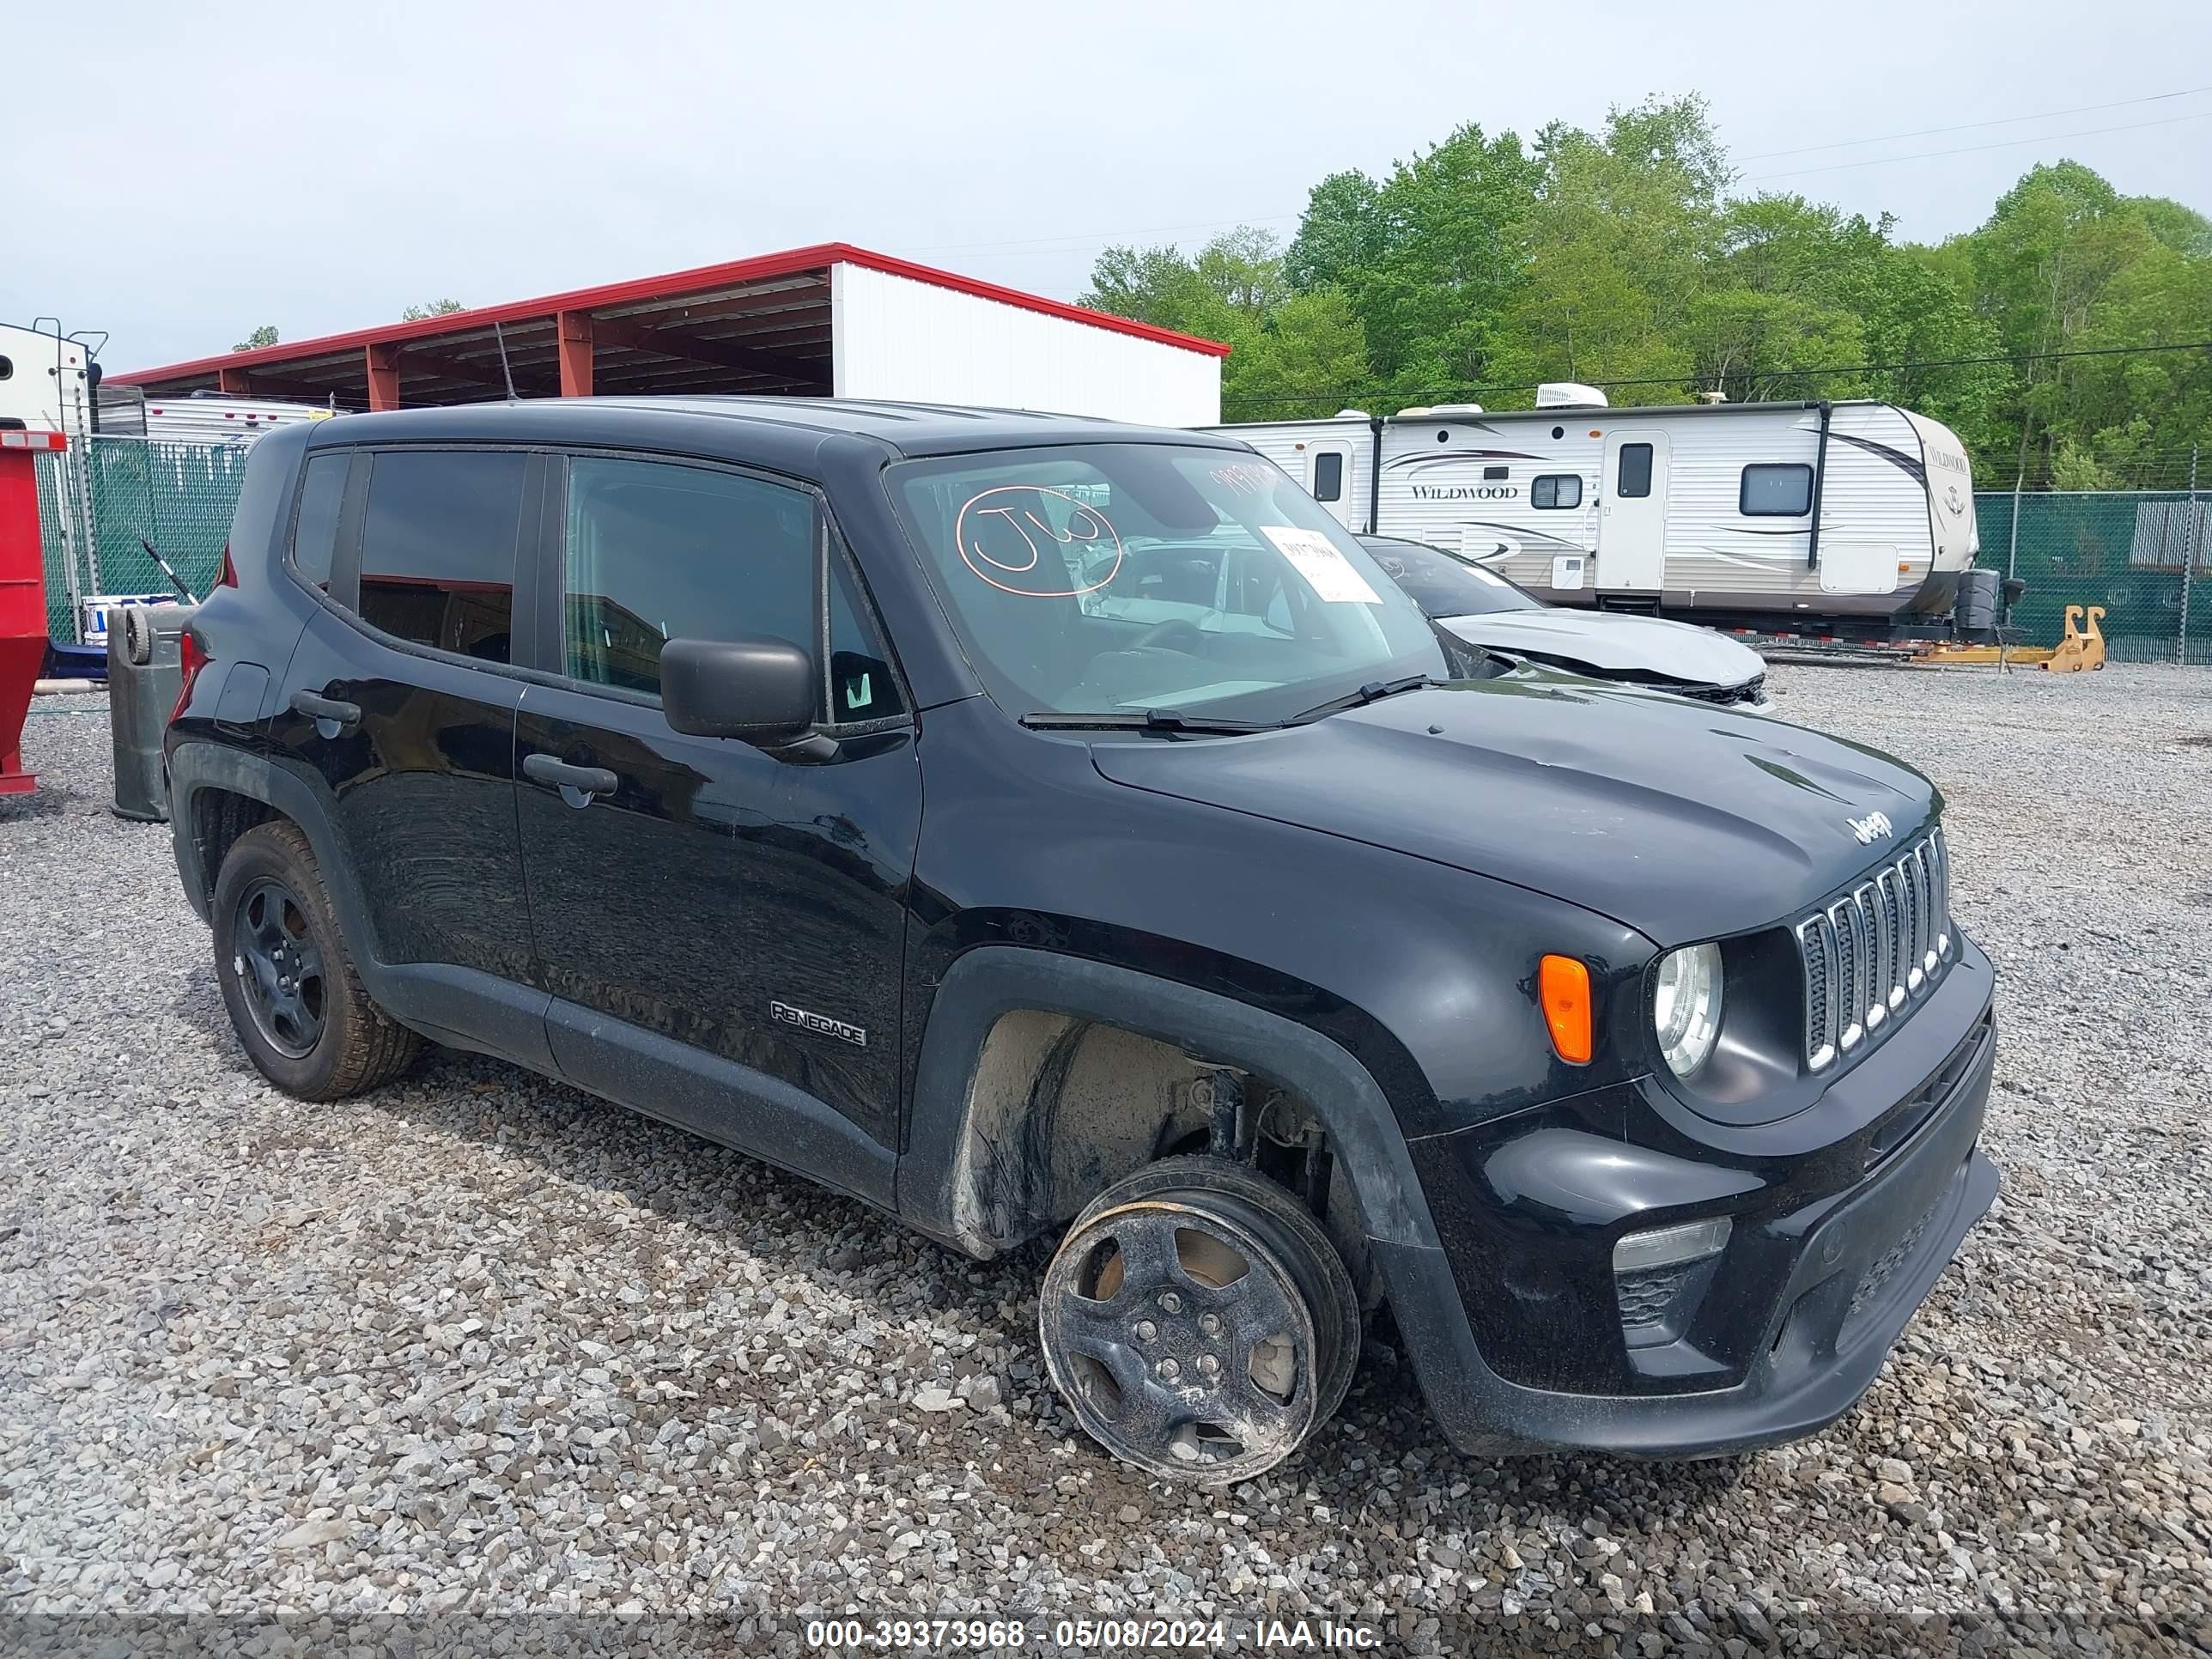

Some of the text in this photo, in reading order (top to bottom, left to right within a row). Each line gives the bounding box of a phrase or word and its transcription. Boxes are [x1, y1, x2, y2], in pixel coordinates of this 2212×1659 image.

[1412, 485, 1518, 500] WILDWOOD
[1846, 811, 1893, 845] Jeep
[771, 1000, 866, 1046] RENEGADE
